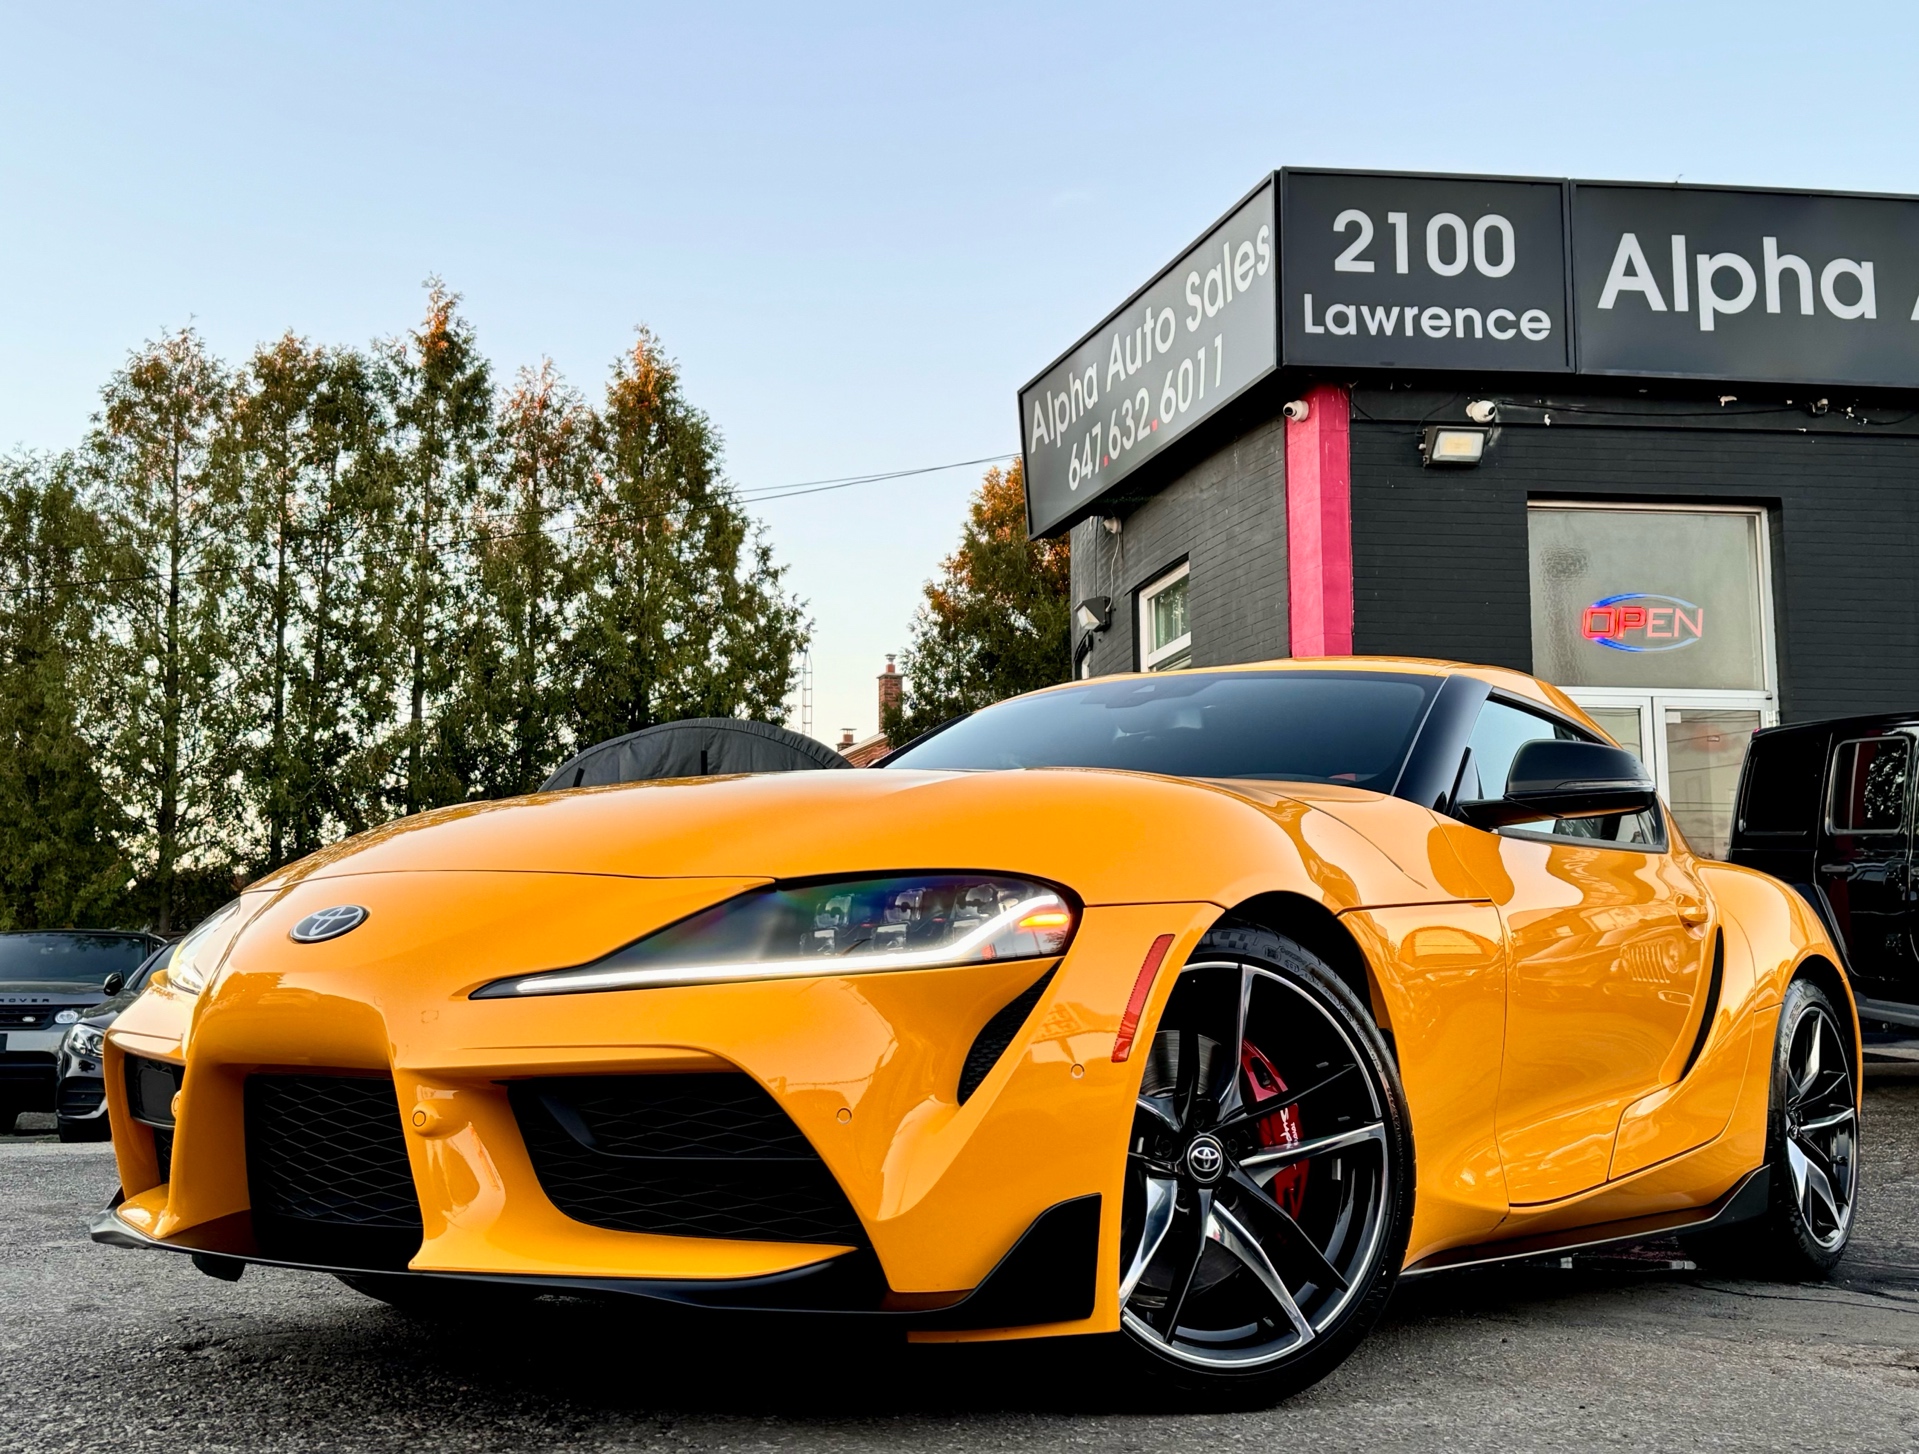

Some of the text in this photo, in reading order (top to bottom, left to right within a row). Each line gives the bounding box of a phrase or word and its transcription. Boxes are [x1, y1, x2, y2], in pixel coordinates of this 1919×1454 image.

[1333, 209, 1516, 278] 2100
[1597, 232, 1877, 332] Alpha
[1031, 224, 1271, 454] Alpha Auto Sales
[1304, 293, 1552, 341] Lawrence
[1068, 333, 1224, 491] 647.632.6011
[1582, 606, 1704, 640] OPEN
